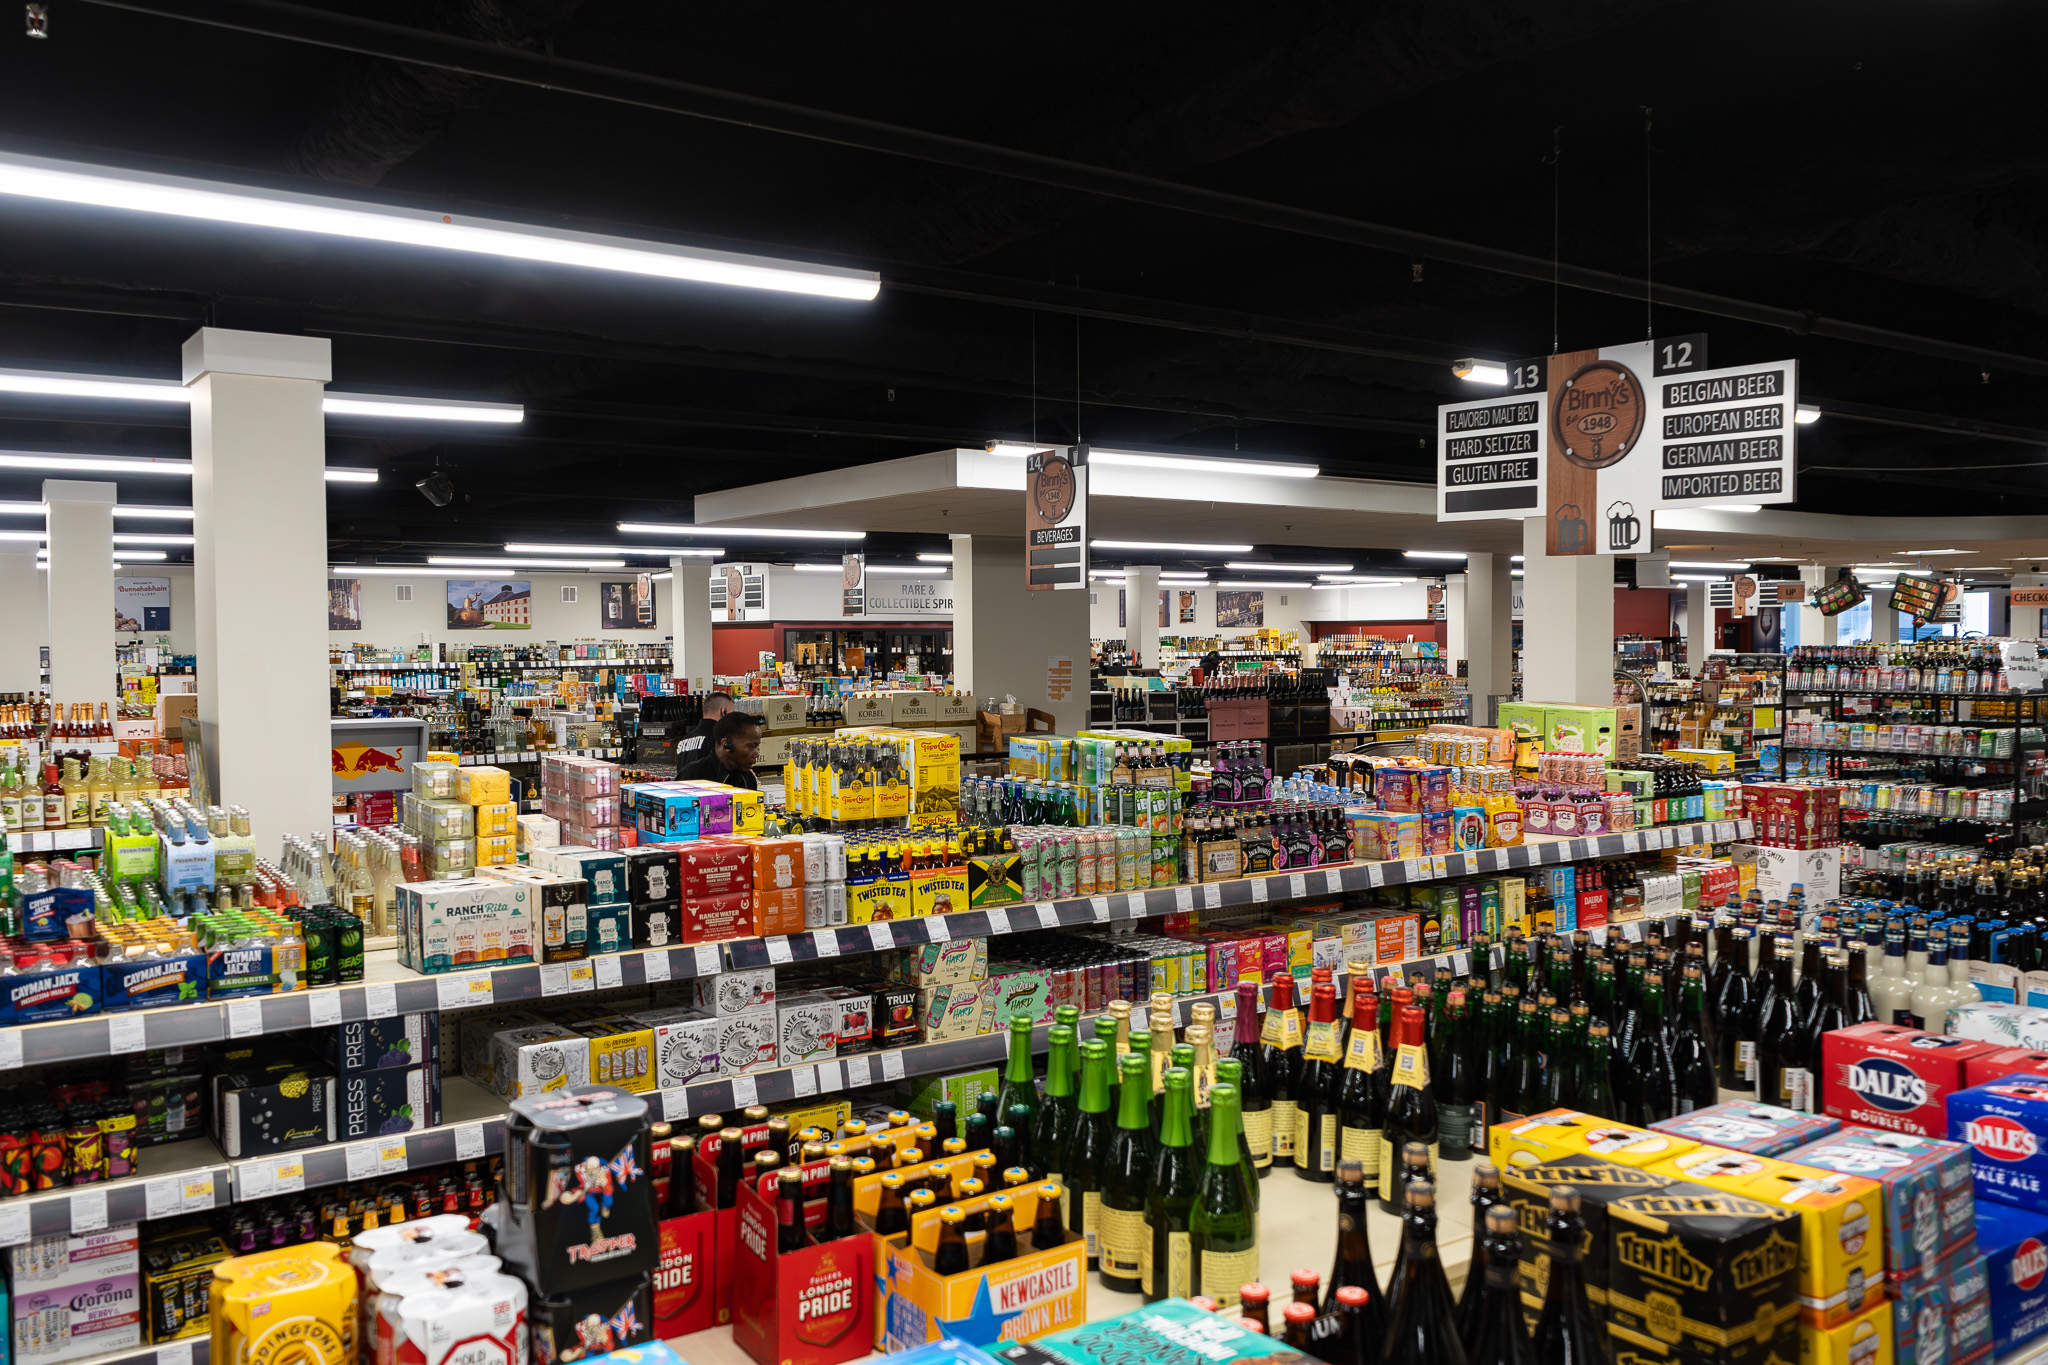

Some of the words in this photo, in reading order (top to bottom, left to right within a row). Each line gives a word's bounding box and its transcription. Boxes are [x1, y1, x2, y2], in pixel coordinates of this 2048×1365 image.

[1662, 342, 1692, 370] 12
[1513, 365, 1539, 389] 13
[1568, 381, 1629, 411] Binny's
[1671, 380, 1734, 404] BELGIAN
[1737, 375, 1775, 396] BEER
[1450, 408, 1491, 433] FLAVORED
[1492, 407, 1516, 426] MALT
[1518, 403, 1535, 422] BEV
[1583, 415, 1611, 431] 1948
[1666, 412, 1742, 436] EUROPEAN
[1745, 408, 1780, 428] BEER
[1451, 438, 1482, 457] HARD
[1485, 433, 1531, 454] SELTZER
[1667, 444, 1738, 465] GERMAN
[1741, 439, 1778, 460] BEER
[1029, 456, 1041, 471] 14
[1453, 465, 1498, 483] GLUTEN
[1501, 462, 1528, 479] FREE
[1664, 475, 1739, 496] IMPORTED
[1743, 472, 1780, 492] BEER
[1048, 492, 1060, 500] 1948
[1037, 529, 1073, 543] BEVERAGES
[902, 585, 926, 595] RARE
[929, 585, 935, 595] &
[870, 598, 930, 609] COLLECTIBLE
[933, 598, 953, 608] SPIR
[776, 713, 799, 722] KORBEL
[858, 710, 884, 718] KORBEL
[921, 742, 938, 752] Topo
[938, 741, 955, 752] Chico
[1386, 775, 1410, 783] SMIRNOFF
[1430, 775, 1447, 783] SMIRNOFF
[1393, 783, 1403, 791] ICE
[842, 796, 856, 804] Topo
[855, 795, 871, 804] Chico
[879, 794, 892, 802] Topo
[892, 793, 906, 801] Chico
[1527, 803, 1549, 811] SMIRNOFF
[1582, 804, 1604, 813] SMIRNOFF
[918, 817, 934, 826] Topo
[934, 815, 952, 824] Chico
[1495, 813, 1518, 822] SMIRNOFF
[1532, 810, 1544, 819] ICE
[1436, 826, 1445, 834] ICE
[1502, 823, 1512, 831] ICE
[1288, 845, 1297, 853] JACK
[1297, 844, 1310, 852] DANIEL'S
[1326, 840, 1334, 849] JACK
[1334, 838, 1346, 847] DANIEL'S
[1249, 848, 1258, 858] JACK
[1258, 847, 1271, 856] DANIEL'S
[1743, 850, 1766, 860] SAMUEL
[1767, 850, 1785, 864] SMITH
[1806, 853, 1820, 865] SAMUEL
[1820, 852, 1833, 862] SMITH
[857, 887, 890, 902] TWISTED
[892, 887, 906, 897] TEA
[918, 880, 949, 895] TWISTED
[951, 881, 964, 891] TEA
[29, 896, 55, 910] CAYMAN
[1584, 895, 1603, 904] DAURA
[33, 905, 51, 916] JACK
[447, 905, 484, 917] RANCH
[485, 902, 509, 912] Rita
[699, 912, 719, 920] RANCH
[1379, 920, 1402, 932] spindrift
[943, 940, 969, 951] AriZona
[223, 950, 261, 966] CAYMAN
[278, 951, 300, 963] ZERO
[946, 953, 967, 965] HARD
[123, 966, 161, 988] CAYMAN
[160, 961, 188, 978] JACK
[224, 963, 250, 975] JACK
[10, 977, 52, 1001] CAYMAN
[52, 972, 80, 988] JACK
[219, 976, 269, 986] MARGARITA
[719, 979, 731, 1002] WHITE
[730, 978, 748, 988] CLAW
[1008, 981, 1036, 997] AriZona
[887, 993, 915, 1006] TRULY
[950, 992, 975, 1005] AriZona
[1011, 998, 1033, 1011] HARD
[839, 1000, 870, 1013] TRULY
[953, 1006, 974, 1019] HARD
[783, 1013, 797, 1042] WHITE
[797, 1011, 820, 1023] CLAW
[720, 1024, 735, 1054] WHITE
[735, 1021, 760, 1034] CLAW
[661, 1034, 676, 1066] WHITE
[677, 1032, 702, 1044] CLAW
[531, 1051, 540, 1074] WHITE
[1848, 1064, 1928, 1105] DALE'S
[313, 1083, 321, 1112] PRESS
[413, 1079, 422, 1116] PRESS
[349, 1078, 364, 1135] PRESS
[1850, 1109, 1901, 1130] DOUBLE
[1904, 1123, 1927, 1136] IPA
[285, 1126, 323, 1141] Pineapple
[1966, 1122, 2038, 1155] DALE'S
[742, 1210, 767, 1238] LONDON
[86, 1235, 112, 1248] BERRY
[741, 1222, 767, 1261] PRIDE
[2012, 1246, 2048, 1283] DALE'S
[799, 1277, 852, 1300] LONDON
[1000, 1262, 1072, 1310] NEWCASTLE
[71, 1286, 133, 1314] Corona
[799, 1289, 852, 1321] PRIDE
[88, 1309, 112, 1320] BERRY
[1003, 1305, 1049, 1341] BROWN
[1054, 1296, 1073, 1323] ALE
